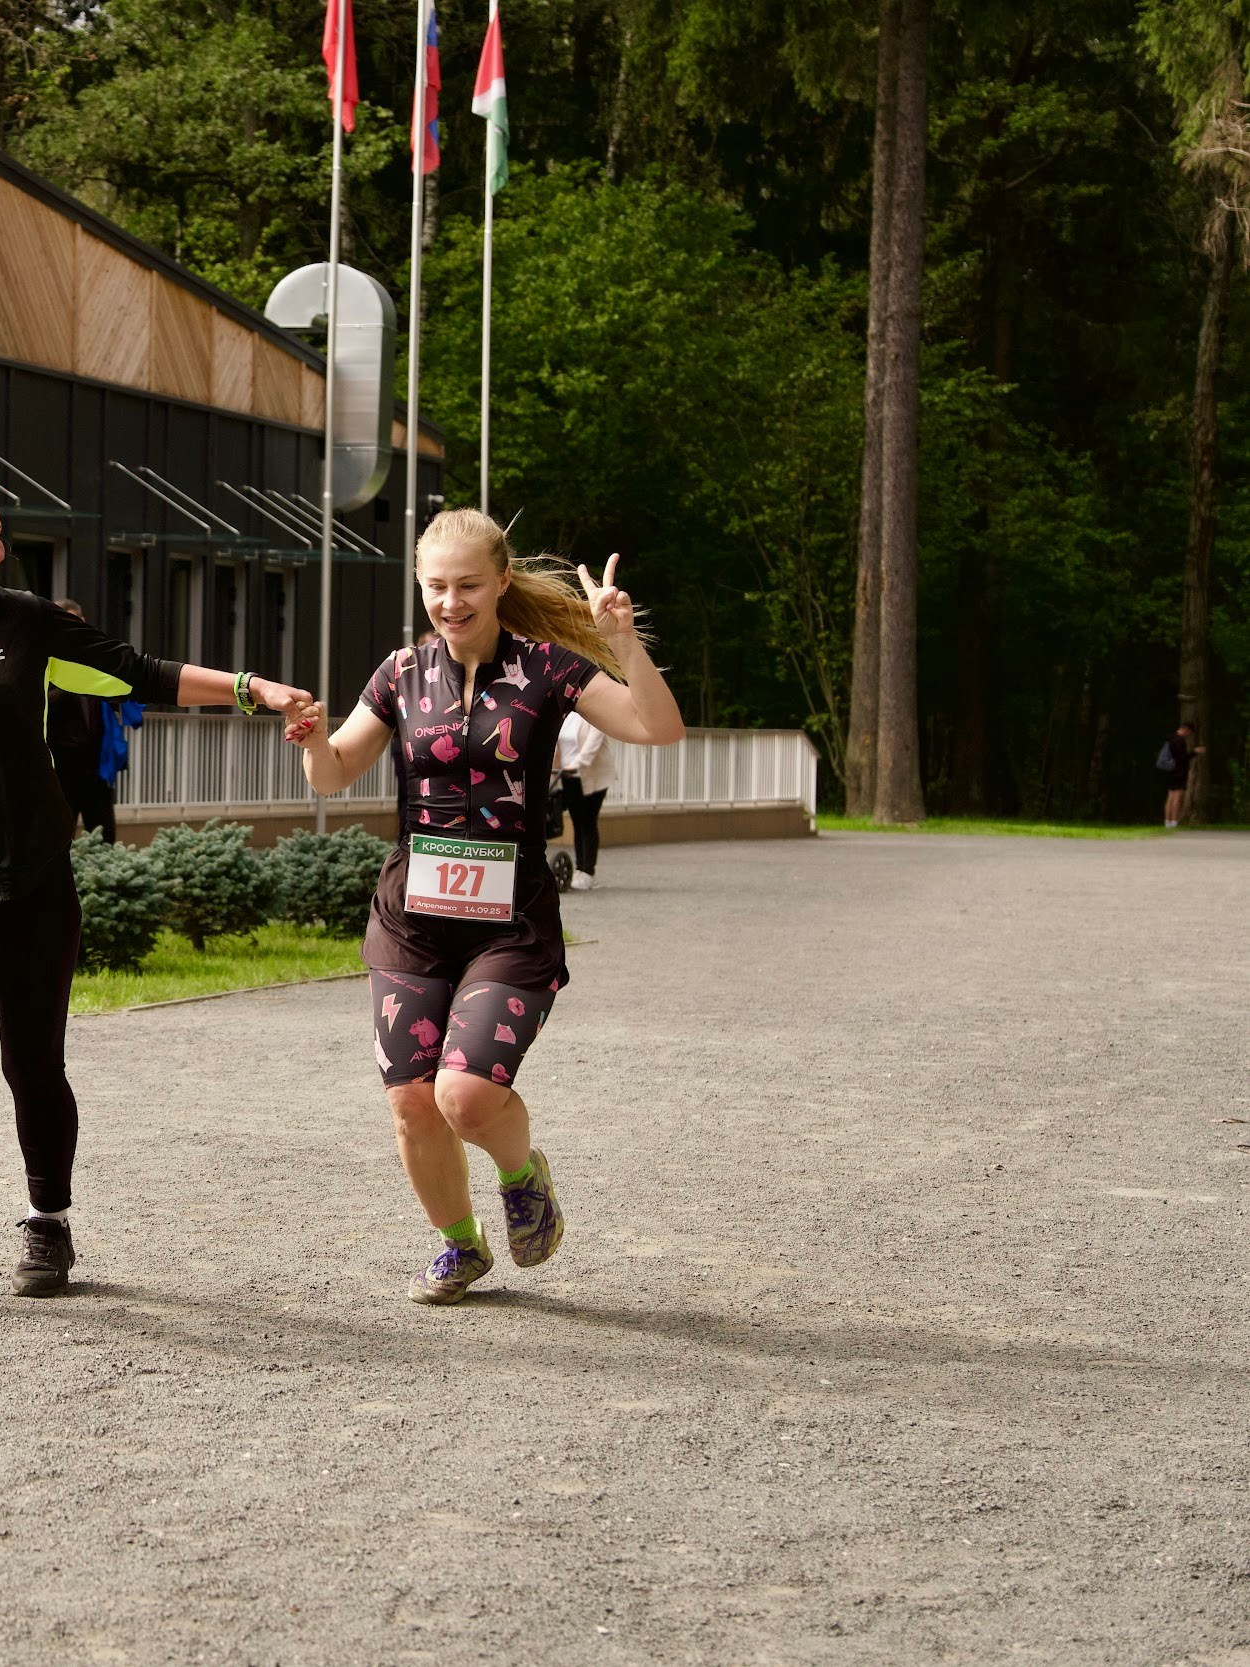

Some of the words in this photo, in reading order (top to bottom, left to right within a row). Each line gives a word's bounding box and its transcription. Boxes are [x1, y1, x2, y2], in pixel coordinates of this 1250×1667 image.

[422, 842, 461, 855] КРОСС
[463, 846, 504, 858] ДУБКИ
[435, 862, 485, 897] 127
[416, 900, 457, 912] Апрелевка
[465, 906, 501, 915] 14.09.25
